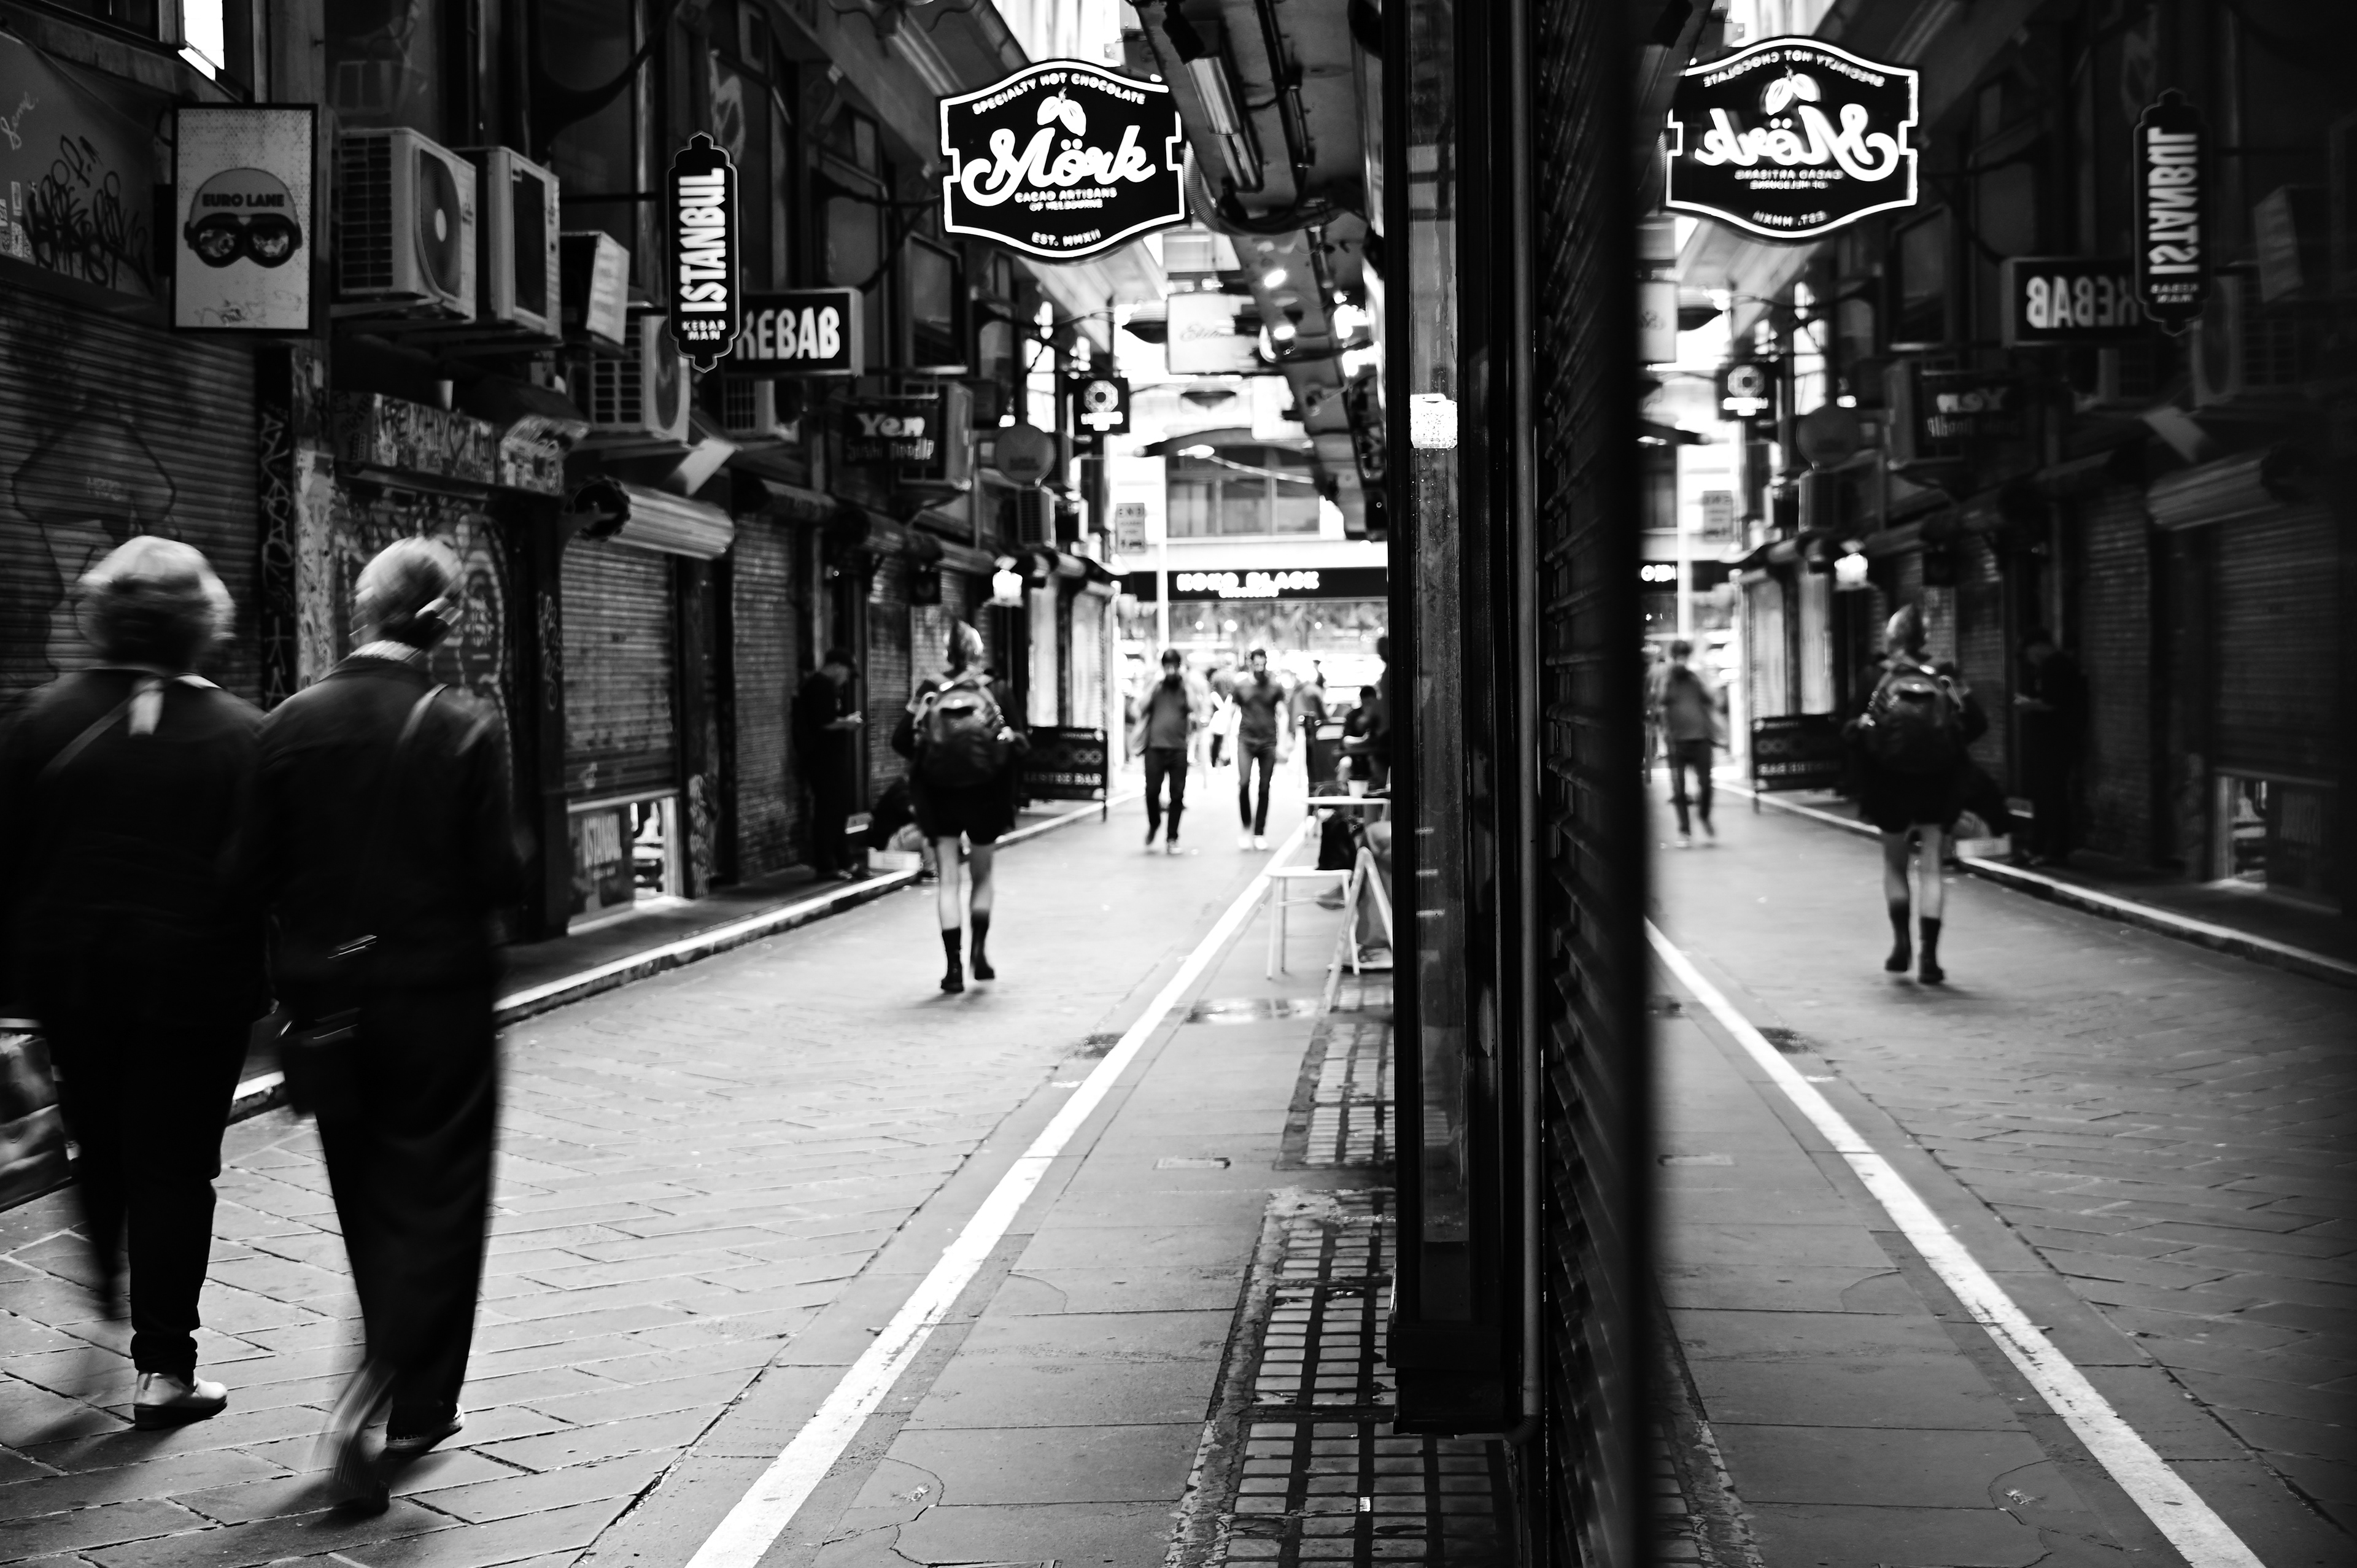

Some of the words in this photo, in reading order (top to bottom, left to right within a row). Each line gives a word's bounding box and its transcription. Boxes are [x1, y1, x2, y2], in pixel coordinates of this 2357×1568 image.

[972, 78, 1037, 115] SPECIALTY
[1040, 72, 1067, 86] HOT
[1070, 72, 1146, 104] CHOCOLATE
[961, 125, 1156, 207] Mörk
[202, 194, 243, 208] EURO
[246, 194, 284, 208] LANE
[1014, 190, 1056, 203] CACAO
[1058, 187, 1117, 201] ARTISANS
[678, 168, 727, 312] ISTANBUL
[1031, 231, 1059, 246] EST.
[1062, 228, 1101, 247] MMXII
[681, 319, 727, 332] KEBAB
[686, 331, 721, 341] MAN
[737, 306, 840, 360] KEBAB
[855, 411, 926, 438] Yen
